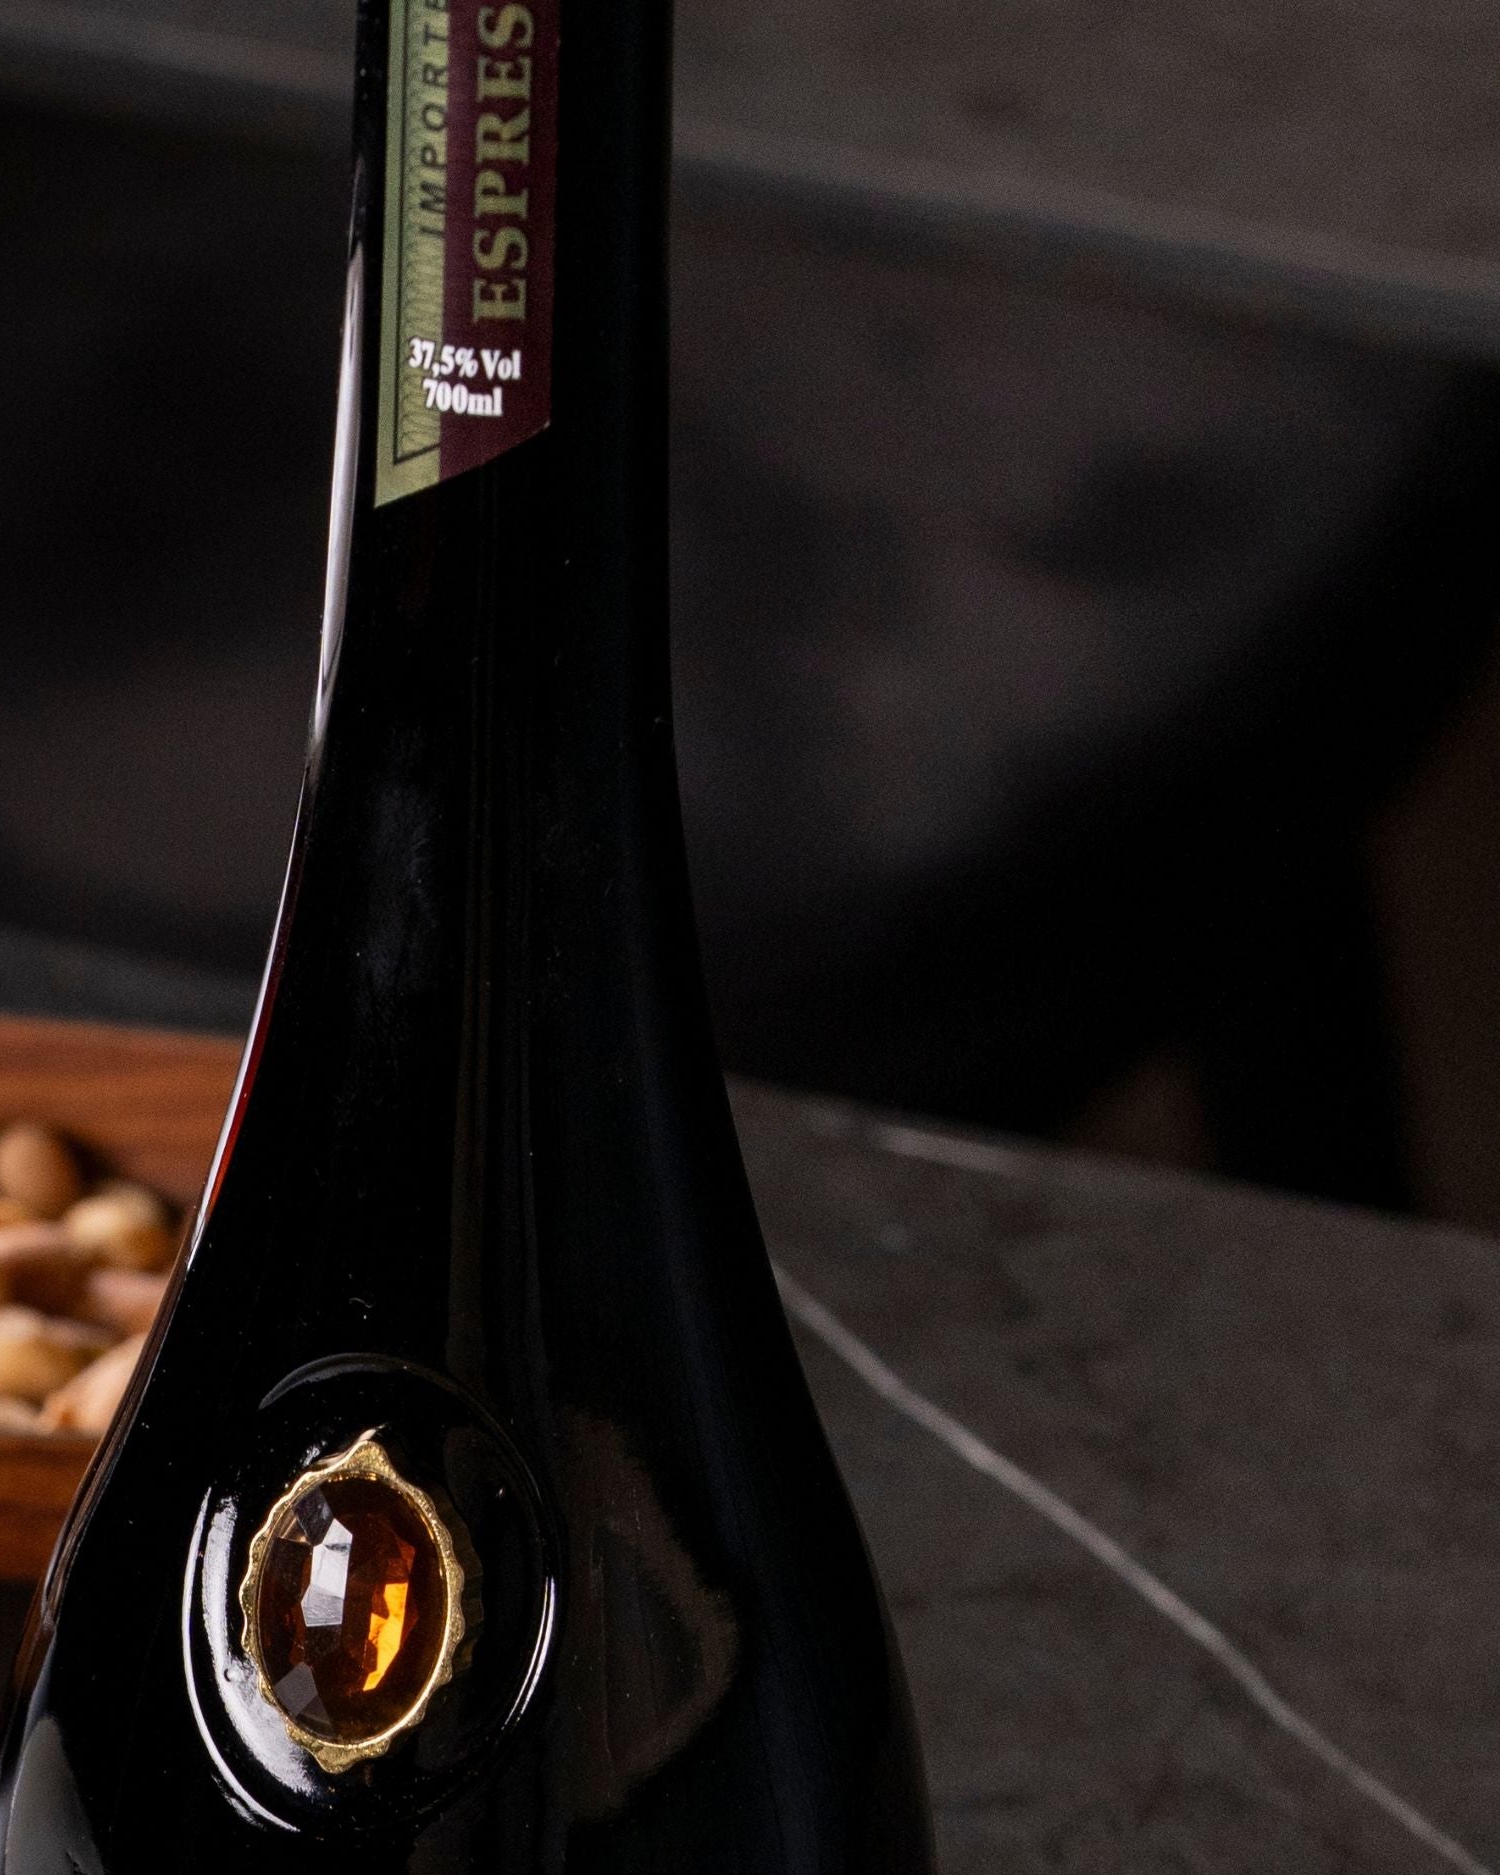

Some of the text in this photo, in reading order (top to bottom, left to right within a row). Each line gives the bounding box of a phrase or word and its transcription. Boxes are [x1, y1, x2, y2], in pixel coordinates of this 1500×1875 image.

[408, 337, 521, 379] 37,5% Vol
[422, 378, 503, 416] 700ml
